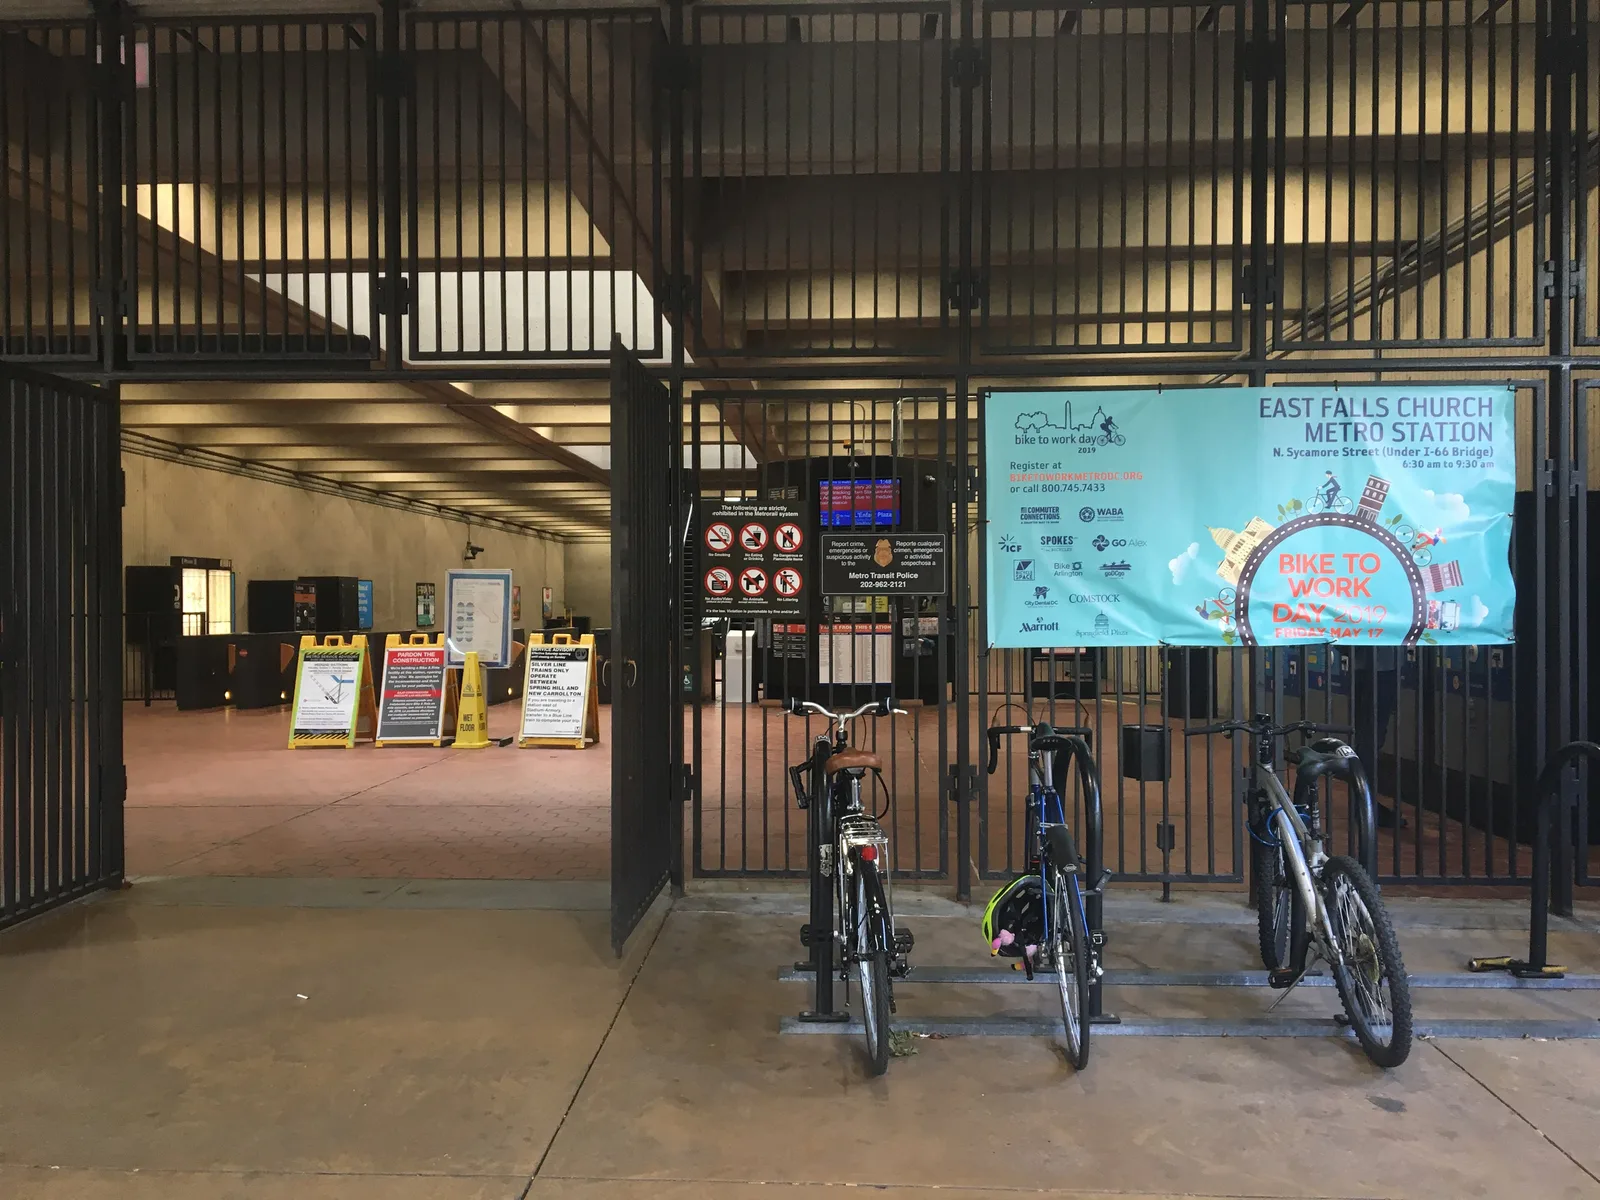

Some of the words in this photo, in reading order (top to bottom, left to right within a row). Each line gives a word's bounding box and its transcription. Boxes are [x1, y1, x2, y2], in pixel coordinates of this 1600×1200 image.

[1260, 398, 1314, 418] EAST
[1322, 398, 1389, 418] FALLS
[1397, 397, 1492, 417] CHURCH
[1305, 422, 1384, 442] METRO
[1392, 422, 1492, 442] STATION
[1015, 434, 1036, 444] bike
[1038, 435, 1048, 444] to
[1052, 434, 1076, 444] work
[1078, 434, 1097, 446] day
[1273, 448, 1284, 456] N.
[1287, 447, 1339, 458] Sycamore
[1342, 447, 1380, 456] Street
[1382, 446, 1420, 458] (Under
[1424, 446, 1449, 456] I-66
[1452, 446, 1494, 458] Bridge)
[1010, 461, 1050, 472] Register
[1052, 461, 1062, 469] at
[1402, 460, 1424, 468] 6:30
[1456, 460, 1478, 468] 9:30
[1010, 472, 1142, 482] BIKETOWORKMETRODC.ORG
[1023, 484, 1038, 492] call
[1042, 484, 1106, 492] 800.745.7433
[1040, 536, 1074, 545] SPOKES
[1279, 553, 1335, 574] BIKE
[1342, 553, 1381, 574] TO
[1288, 577, 1372, 598] WORK
[1272, 603, 1327, 623] DAY
[1334, 605, 1388, 624] 2019
[1019, 622, 1058, 632] Marriott
[1275, 628, 1326, 638] FRIDAY
[1330, 628, 1362, 638] MAY
[1368, 628, 1384, 638] 17
[463, 713, 473, 722] WET
[460, 724, 475, 732] FLOOR
